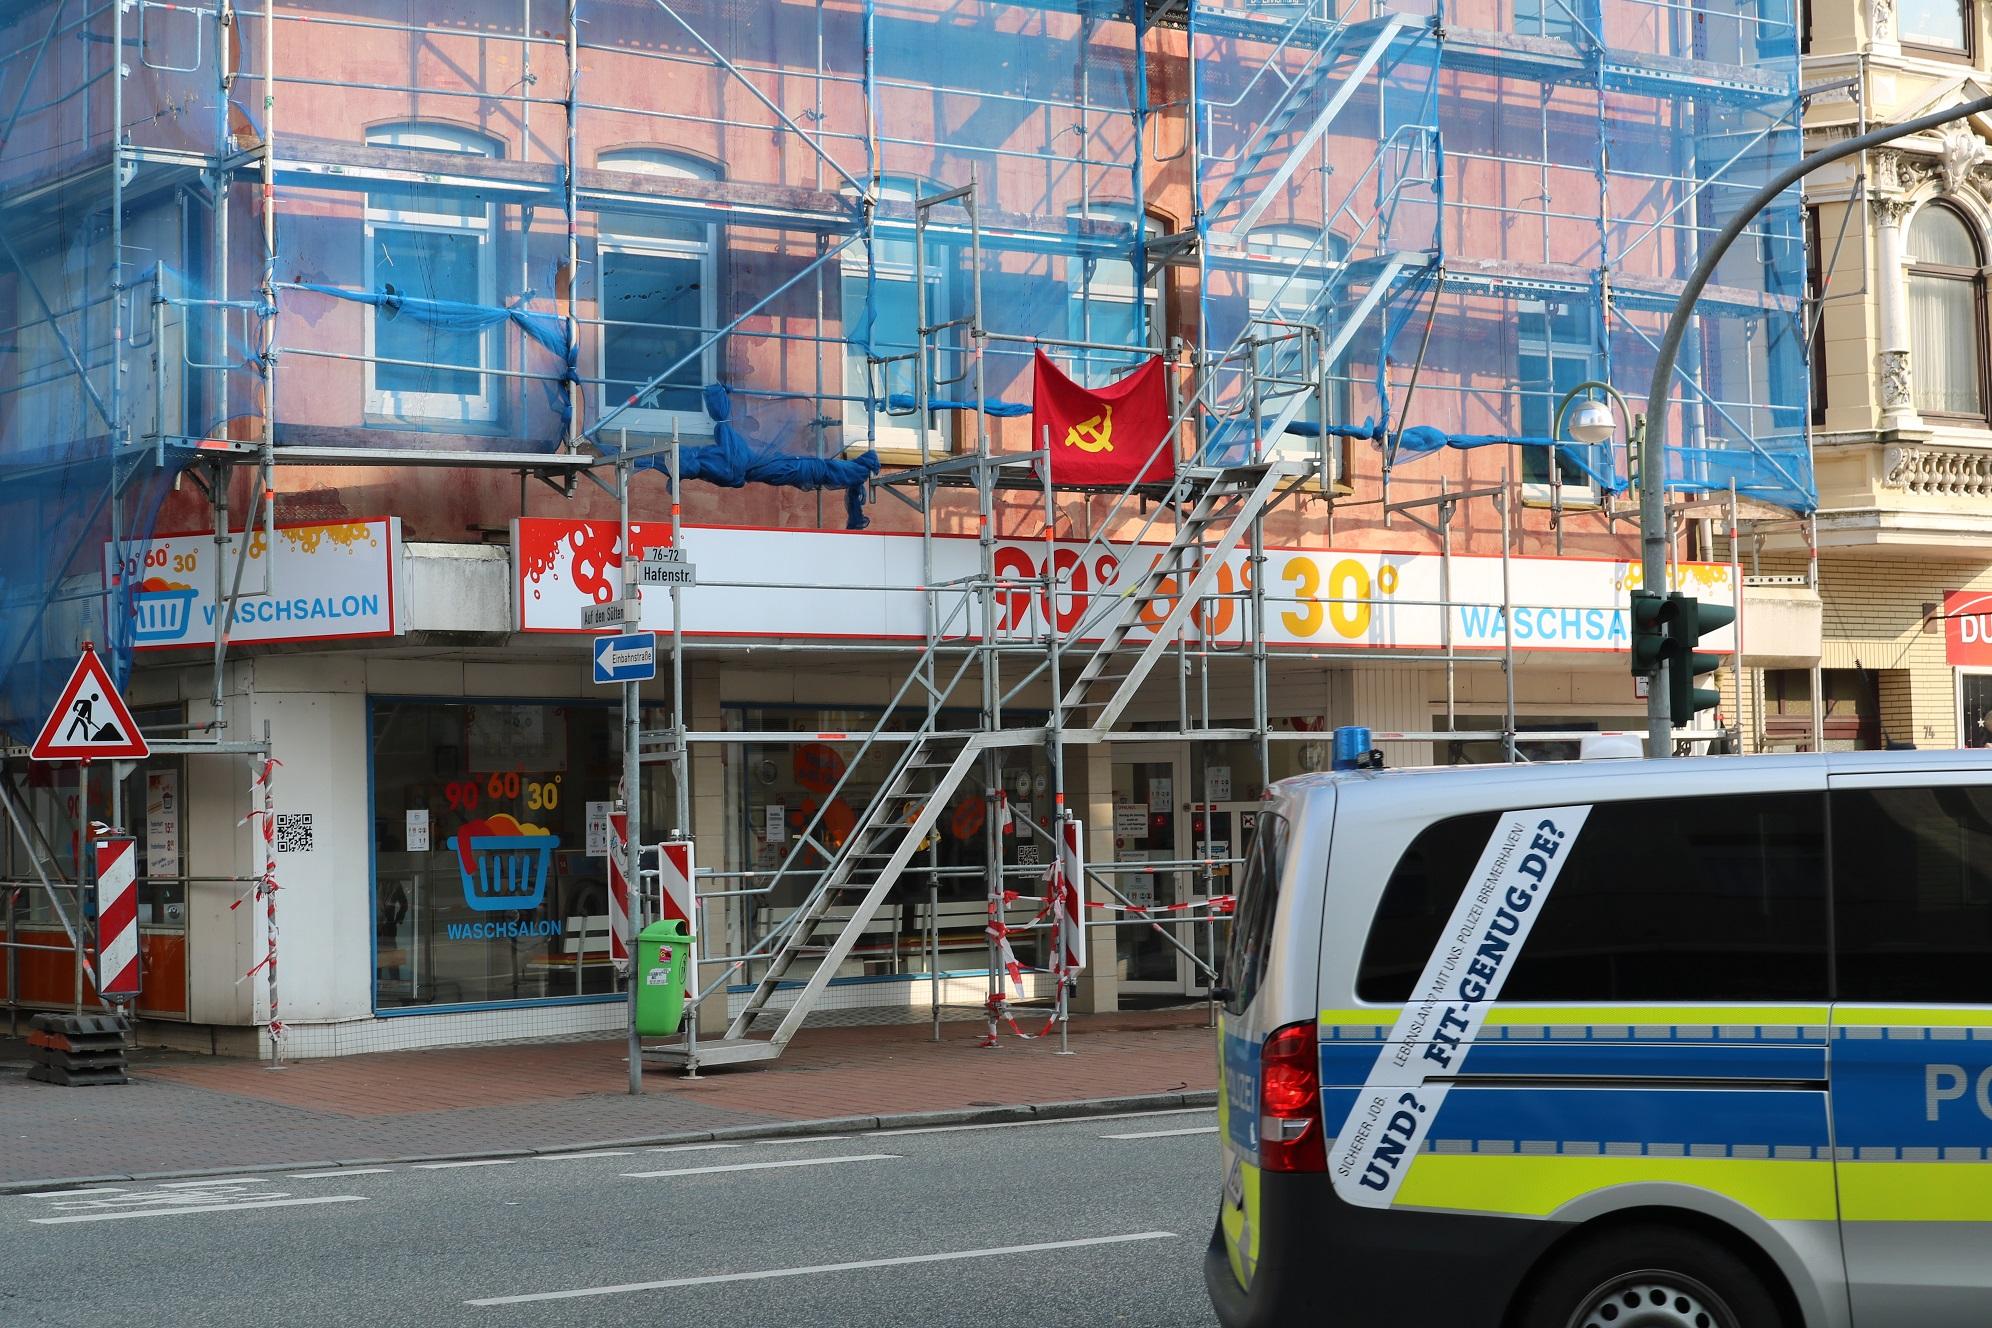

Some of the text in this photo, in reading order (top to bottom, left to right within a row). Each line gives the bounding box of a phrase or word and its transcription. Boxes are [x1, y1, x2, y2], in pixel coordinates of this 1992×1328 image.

[173, 548, 199, 573] 30°
[644, 567, 692, 583] Hafenstr.
[1281, 557, 1398, 639] 30°
[584, 612, 594, 625] Auf
[595, 610, 606, 623] den
[612, 651, 652, 664] Einbahnstraße
[527, 774, 562, 810] 30°
[447, 919, 562, 940] WASCHSALON
[1337, 1120, 1373, 1178] SICHERER
[1370, 1096, 1389, 1122] JOB.
[1432, 969, 1451, 994] MIT
[1456, 902, 1485, 944] POLIZEI
[1476, 822, 1526, 905] BREMERHAVEN!
[1359, 819, 1566, 1192] UND? FIT-GENUG.DE?
